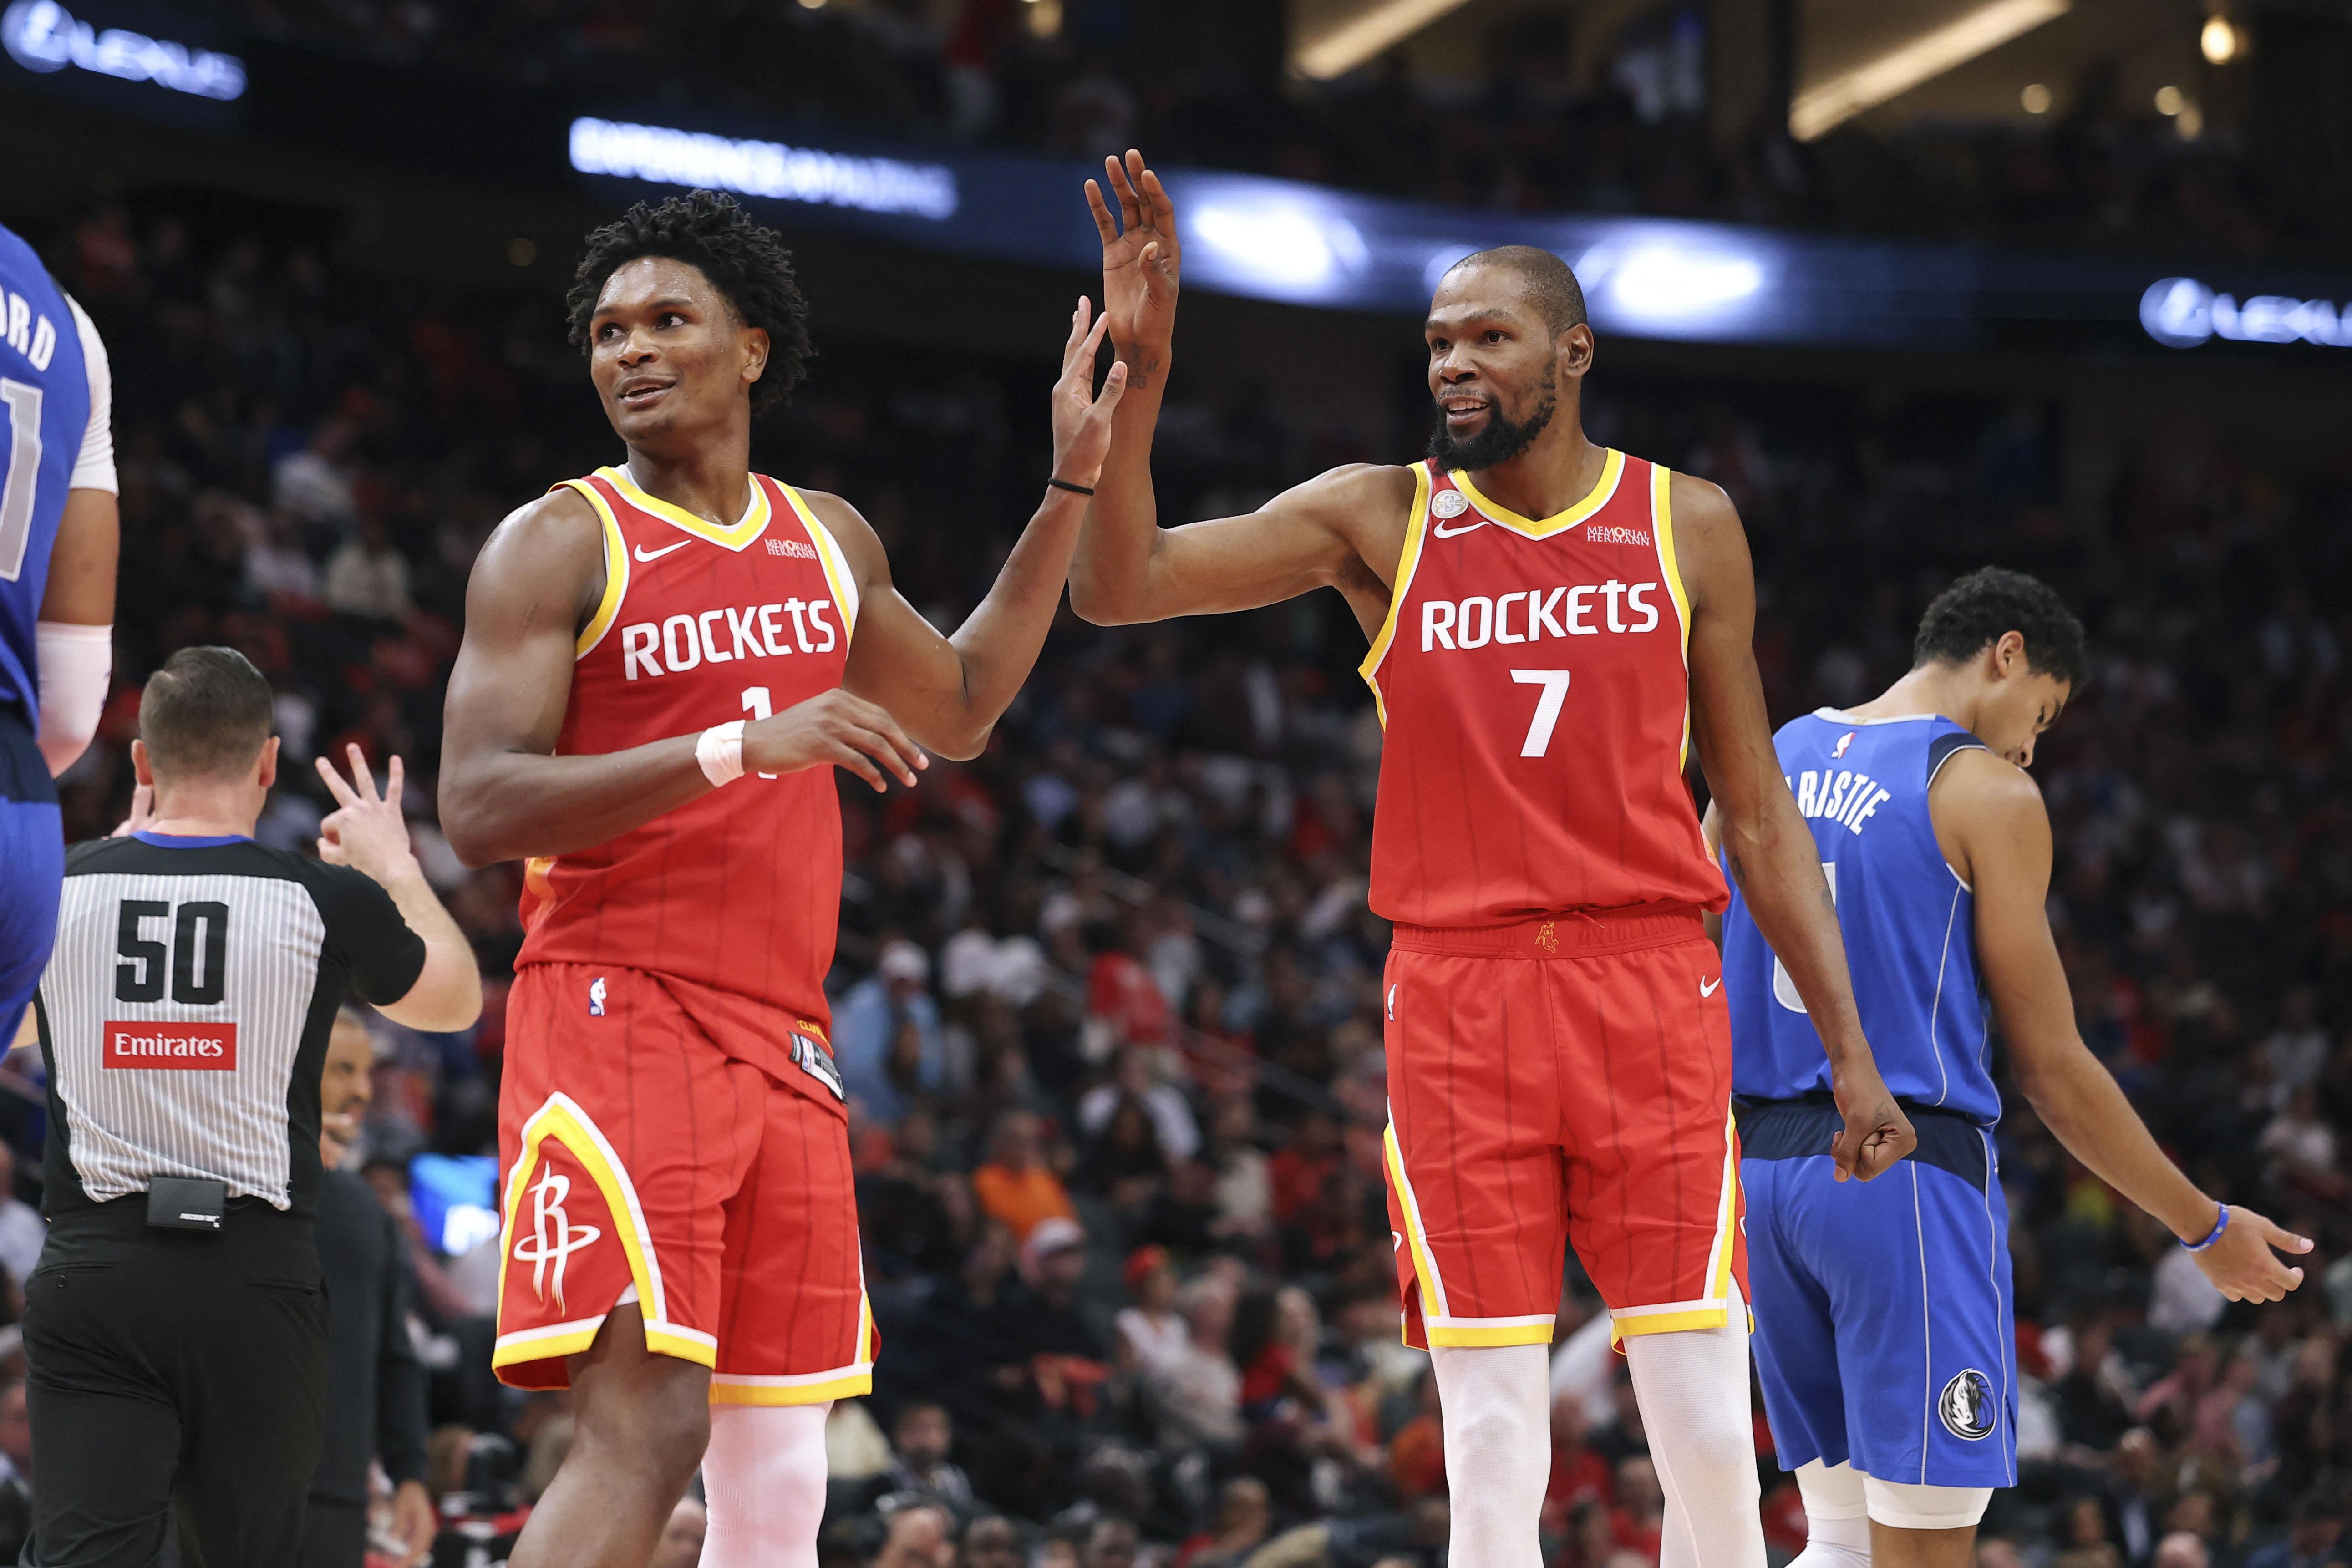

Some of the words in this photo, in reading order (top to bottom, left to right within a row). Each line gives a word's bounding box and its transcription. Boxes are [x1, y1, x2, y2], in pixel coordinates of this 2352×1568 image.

[764, 539, 815, 552] MEMORIAL
[767, 546, 817, 559] HERMANN
[1587, 526, 1650, 539] MEMORIAL
[1587, 533, 1650, 546] HERMANN
[1421, 579, 1658, 652] ROCKETS
[622, 598, 835, 680] ROCKETS
[1509, 669, 1570, 757] 7
[1785, 769, 1891, 836] RISTIE
[116, 900, 229, 1005] 50
[115, 1032, 223, 1057] Emirates
